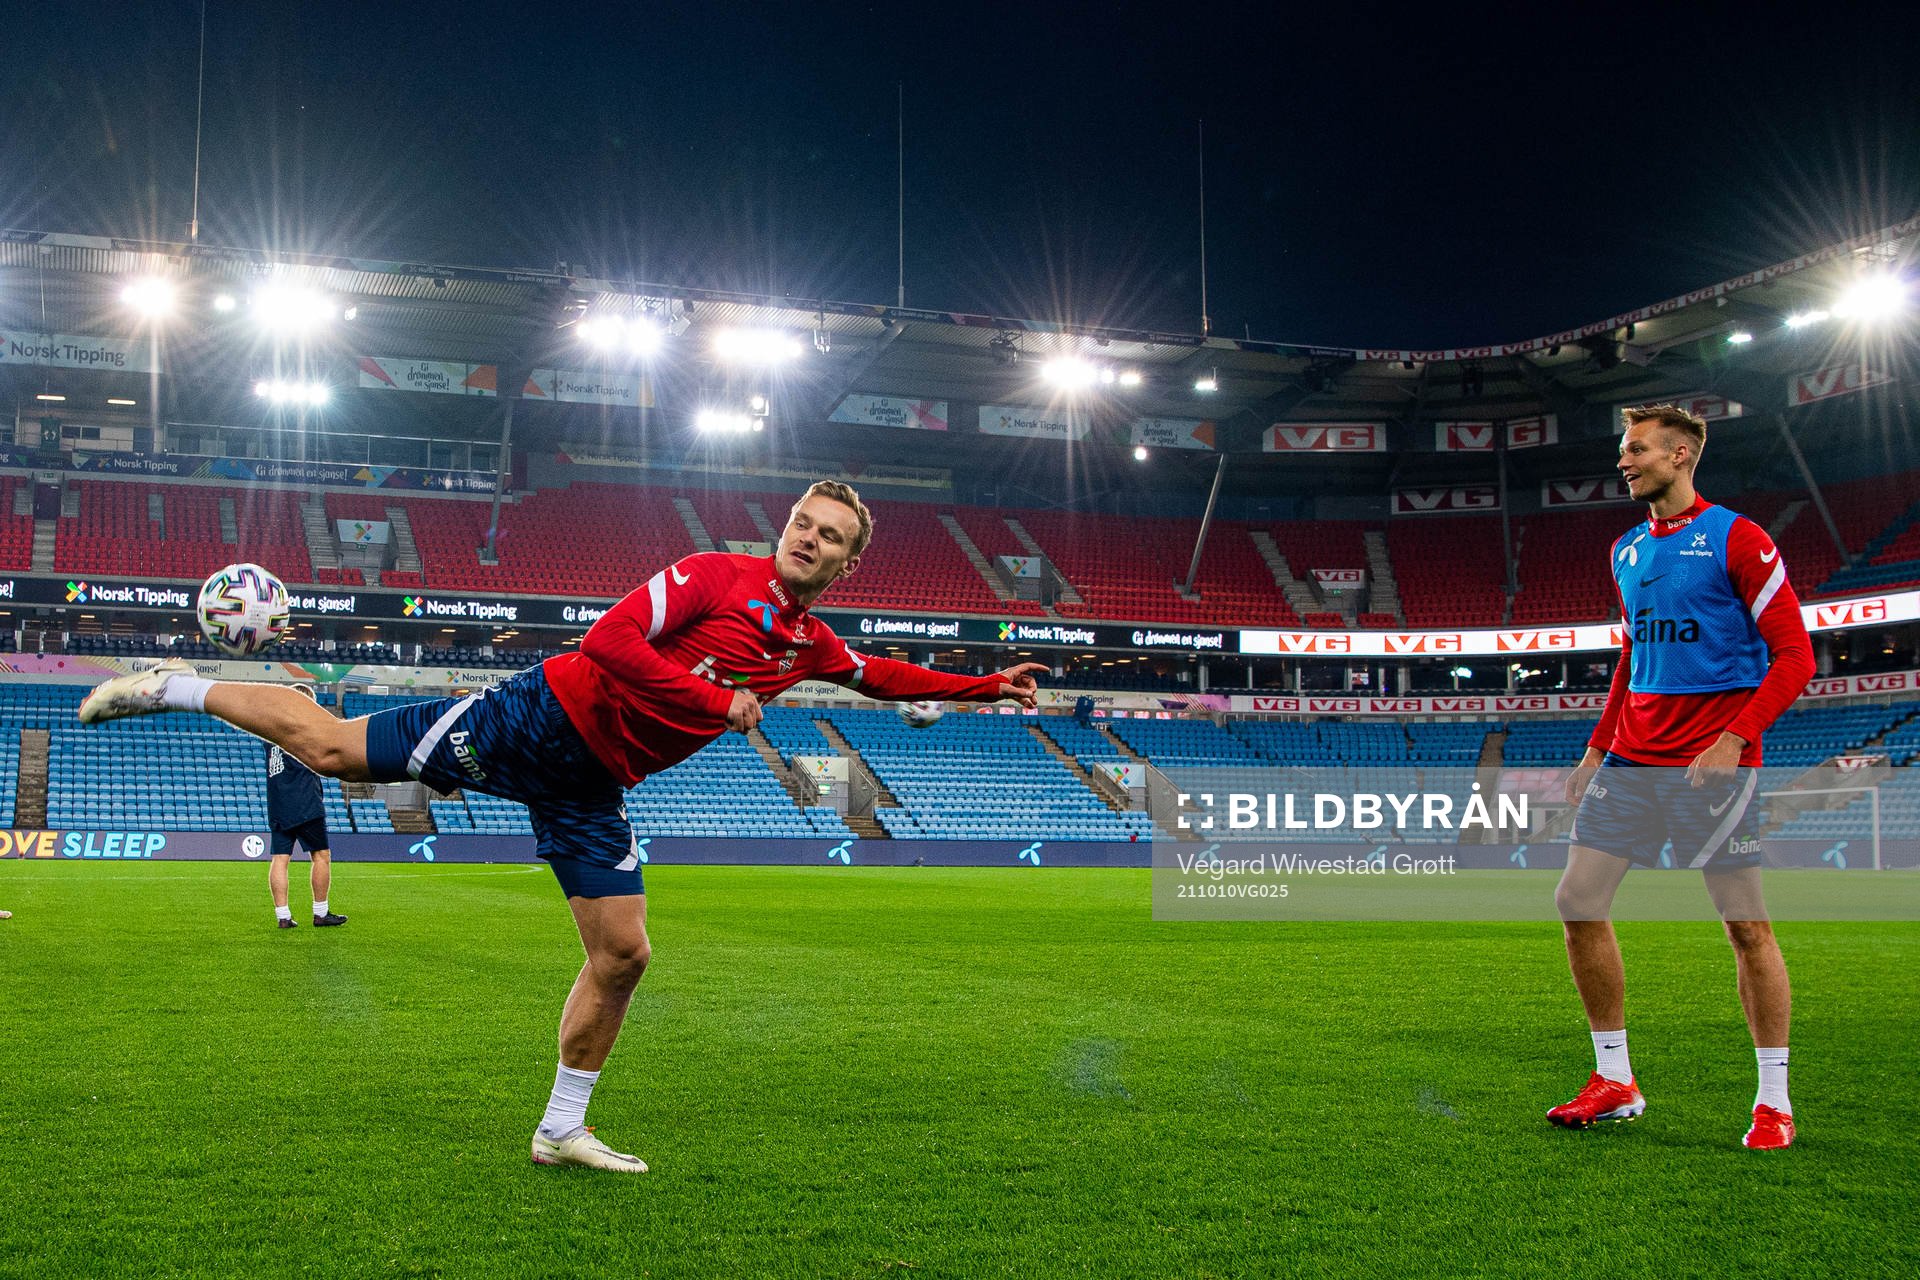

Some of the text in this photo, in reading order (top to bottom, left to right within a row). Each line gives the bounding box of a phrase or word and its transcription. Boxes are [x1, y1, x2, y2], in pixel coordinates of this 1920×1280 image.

[11, 341, 126, 367] Norsk Tipping
[566, 383, 630, 398] Norsk Tipping
[1014, 418, 1069, 432] Norsk Tipping
[1276, 427, 1370, 449] VG
[113, 459, 178, 472] Norsk Tipping
[1401, 488, 1494, 510] VG
[1666, 517, 1693, 529] bama
[1317, 571, 1357, 581] VG
[91, 585, 190, 606] Norsk Tipping
[768, 579, 789, 607] bama
[302, 597, 316, 609] en
[317, 596, 355, 613] sjanse!
[426, 600, 518, 620] Norsk Tipping
[1818, 599, 1885, 626] VG
[562, 606, 576, 622] Gi
[860, 619, 872, 633] Gi
[914, 623, 926, 634] en
[927, 622, 959, 638] sjanse!
[1018, 625, 1095, 644] Norsk Tipping
[1635, 617, 1700, 643] ama
[1132, 631, 1143, 645] Gi
[1181, 634, 1192, 645] en
[1193, 633, 1222, 649] sjanse!
[1280, 635, 1349, 652] VG
[1385, 636, 1459, 652] VG
[1498, 631, 1574, 650] VG
[462, 673, 489, 683] Norsk
[1860, 675, 1905, 691] VG
[805, 685, 814, 694] en
[815, 684, 839, 696] sjanse!
[1805, 681, 1848, 695] VG
[1255, 698, 1299, 711] VG
[1311, 699, 1360, 712] VG
[1371, 699, 1421, 712] VG
[1434, 698, 1484, 711] VG
[1497, 697, 1547, 711] VG
[449, 731, 487, 780] bama
[63, 831, 166, 857] SLEEP
